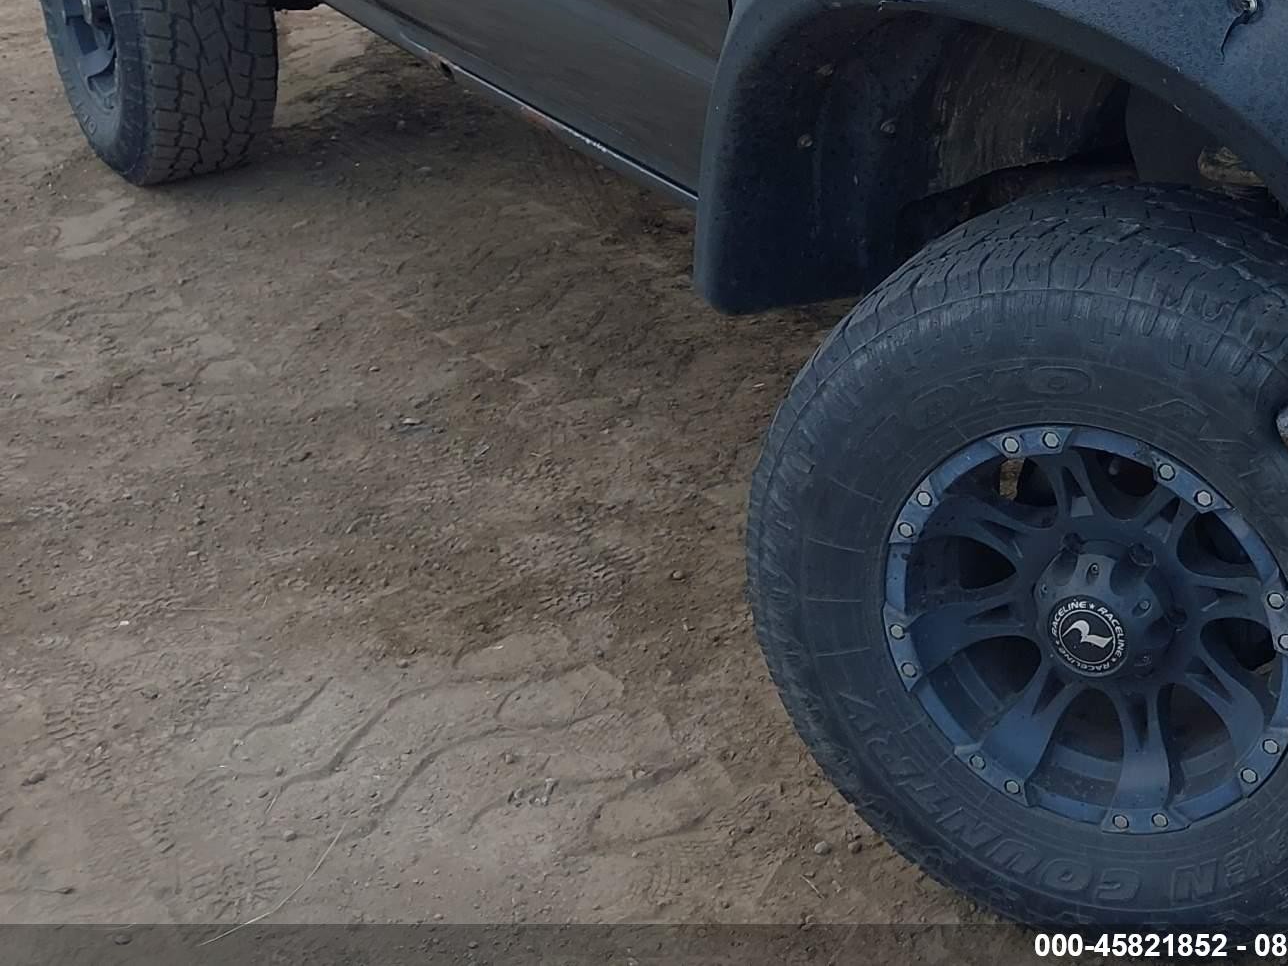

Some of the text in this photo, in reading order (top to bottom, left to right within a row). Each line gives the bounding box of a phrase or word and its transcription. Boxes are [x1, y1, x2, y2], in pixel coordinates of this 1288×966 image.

[1051, 600, 1127, 672] RACELINE RACELINE RACELINE
